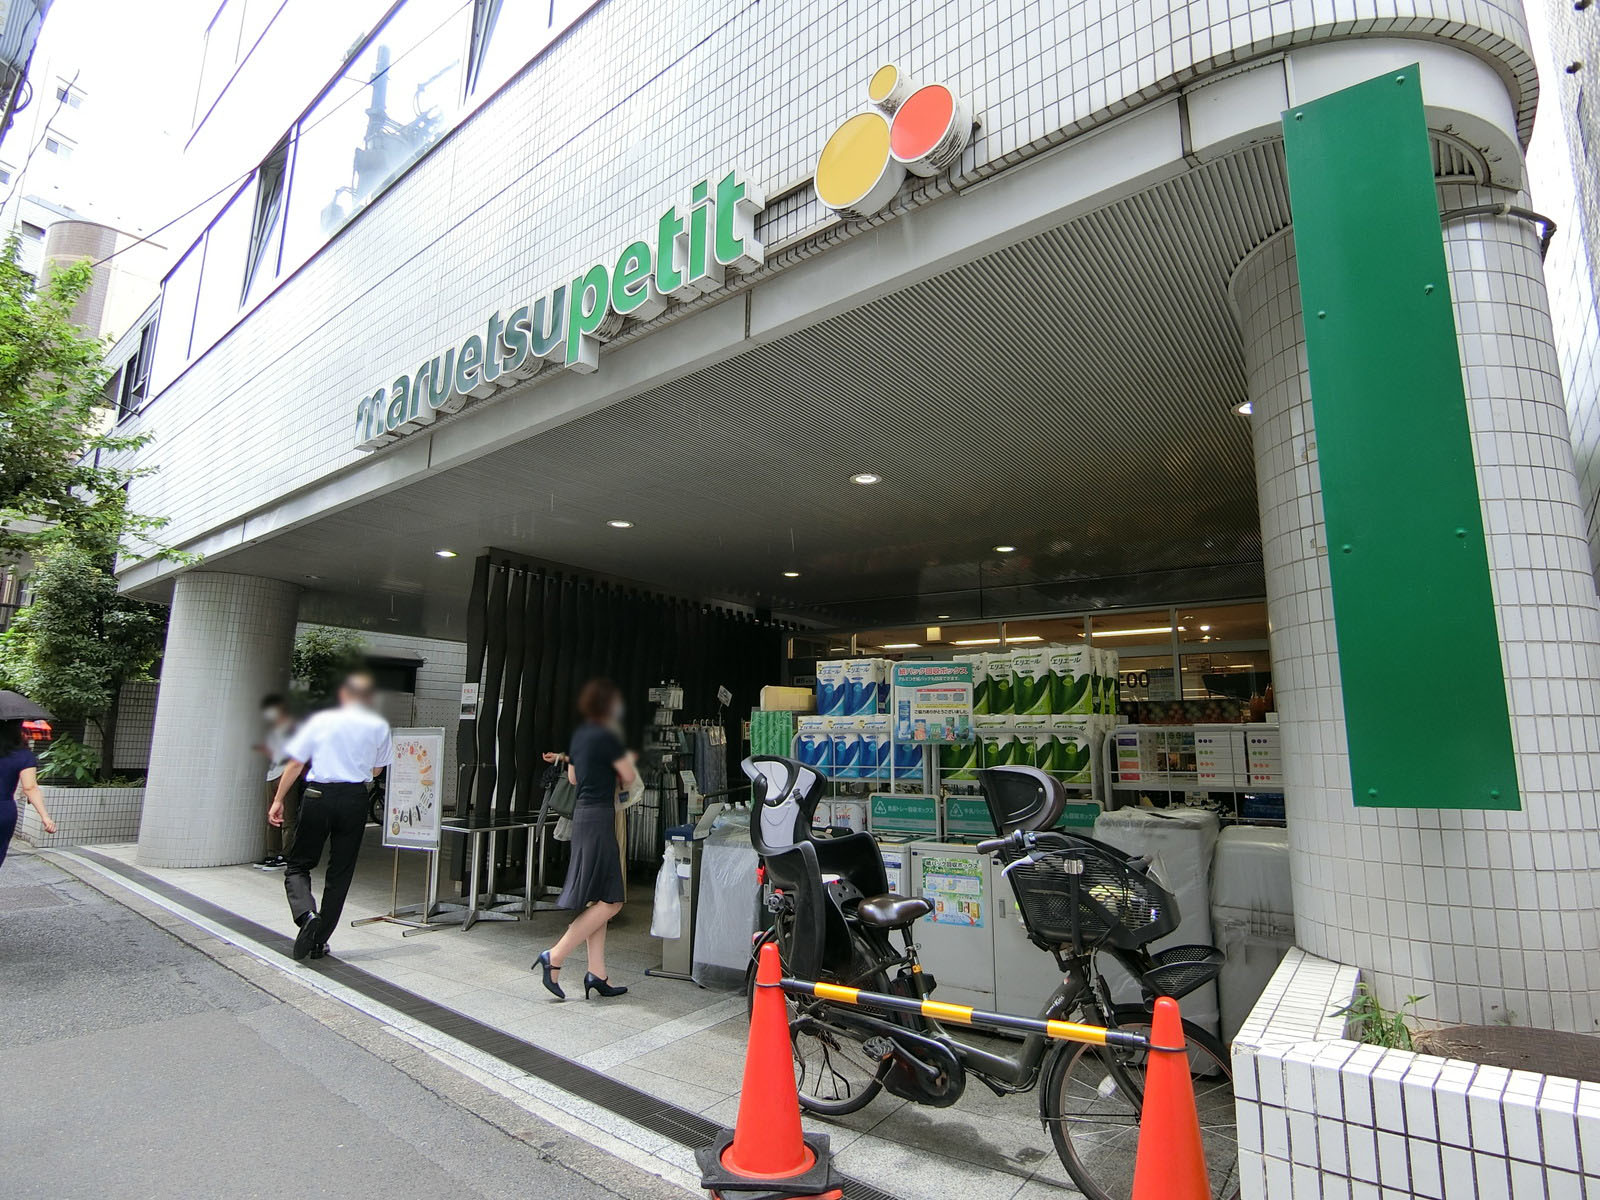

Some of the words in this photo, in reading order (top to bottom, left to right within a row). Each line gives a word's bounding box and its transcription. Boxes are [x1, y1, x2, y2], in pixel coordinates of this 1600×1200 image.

[354, 169, 749, 446] maruetsupetit
[897, 667, 968, 676] 紙パック回収ボックス
[925, 860, 978, 870] 紙パック回収ボックス
